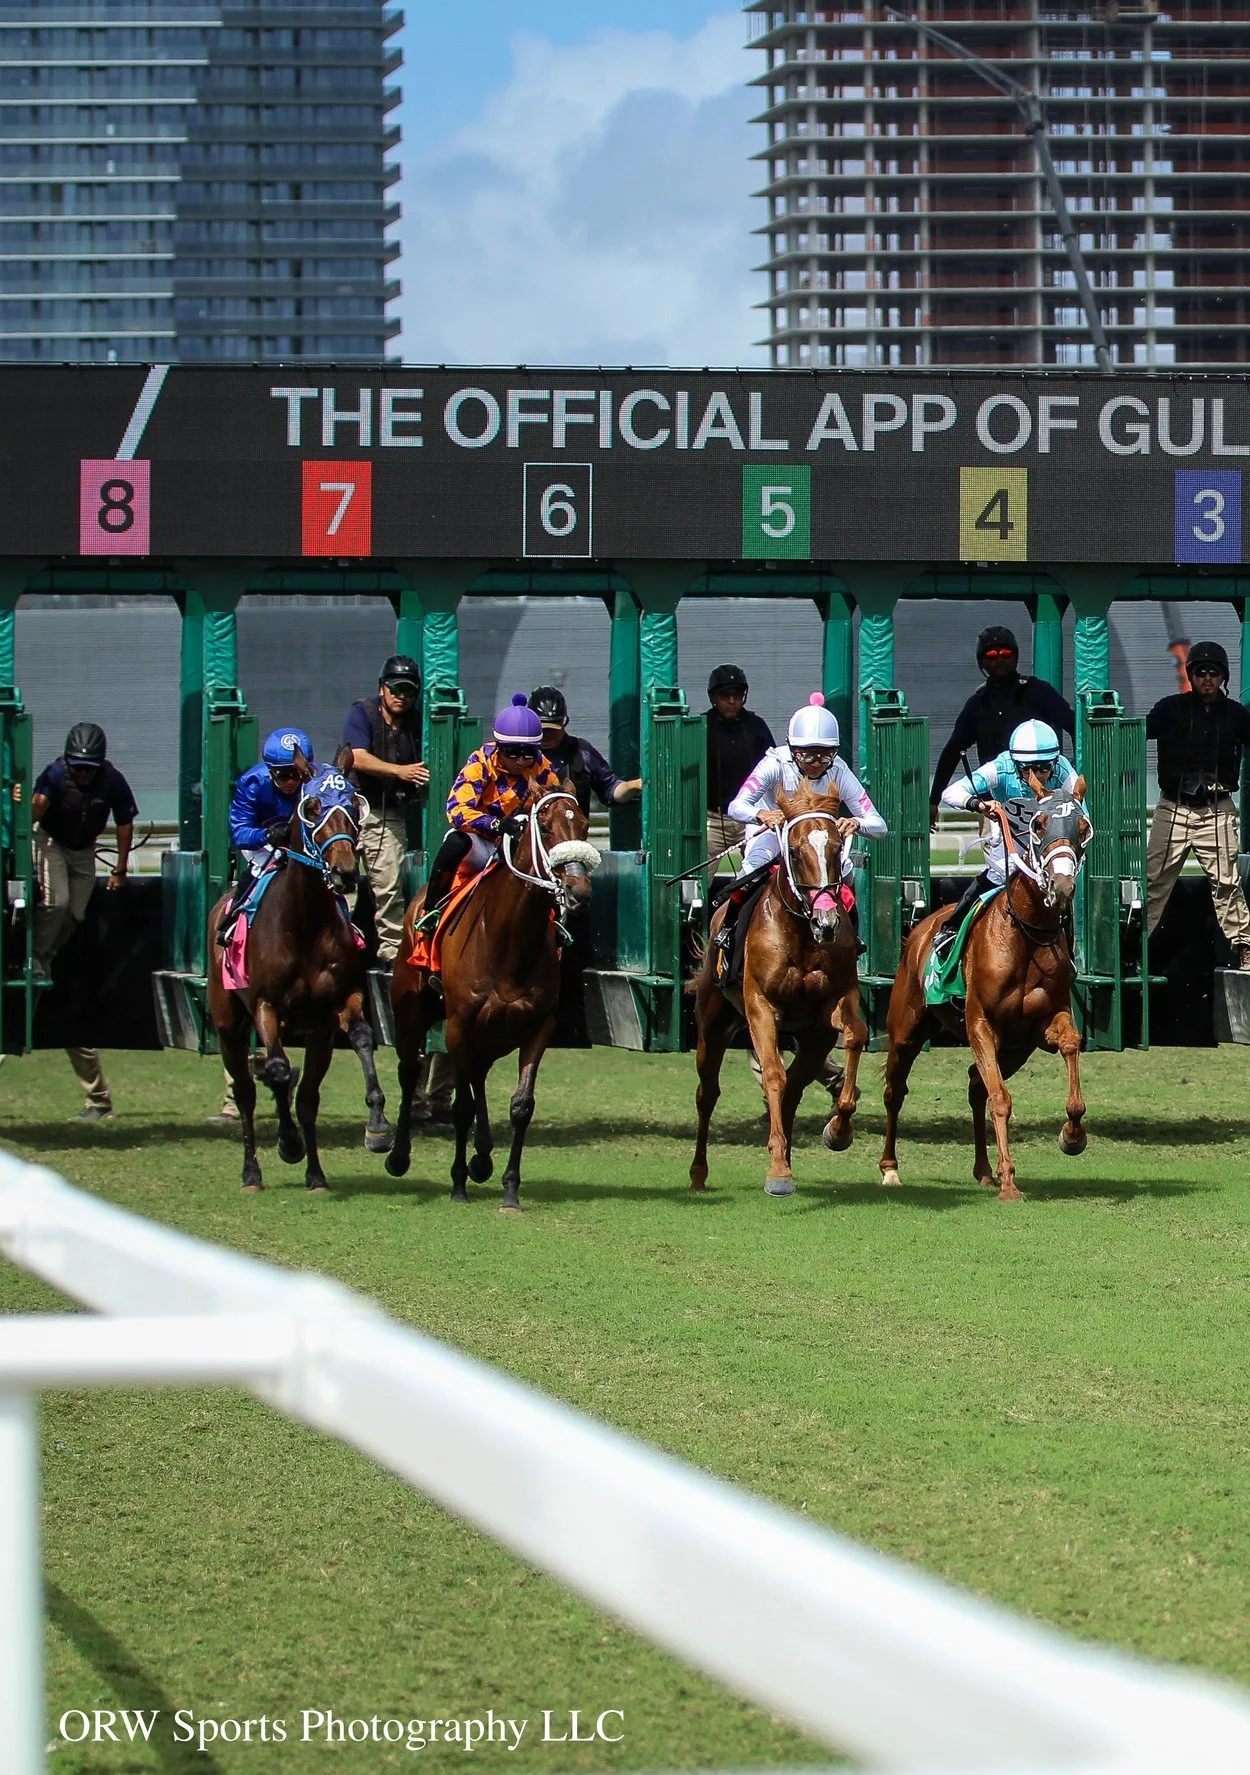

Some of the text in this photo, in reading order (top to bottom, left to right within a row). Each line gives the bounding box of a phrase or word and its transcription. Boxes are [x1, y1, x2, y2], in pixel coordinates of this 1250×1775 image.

[269, 387, 424, 447] THE
[443, 387, 790, 451] OFFICIAL
[806, 392, 957, 452] APP
[975, 393, 1080, 454] OF
[97, 479, 135, 533] 8
[319, 482, 356, 536] 7
[539, 483, 578, 537] 6
[760, 485, 796, 538] 5
[974, 488, 1015, 540] 4
[1191, 489, 1226, 542] 3
[320, 774, 346, 792] AS
